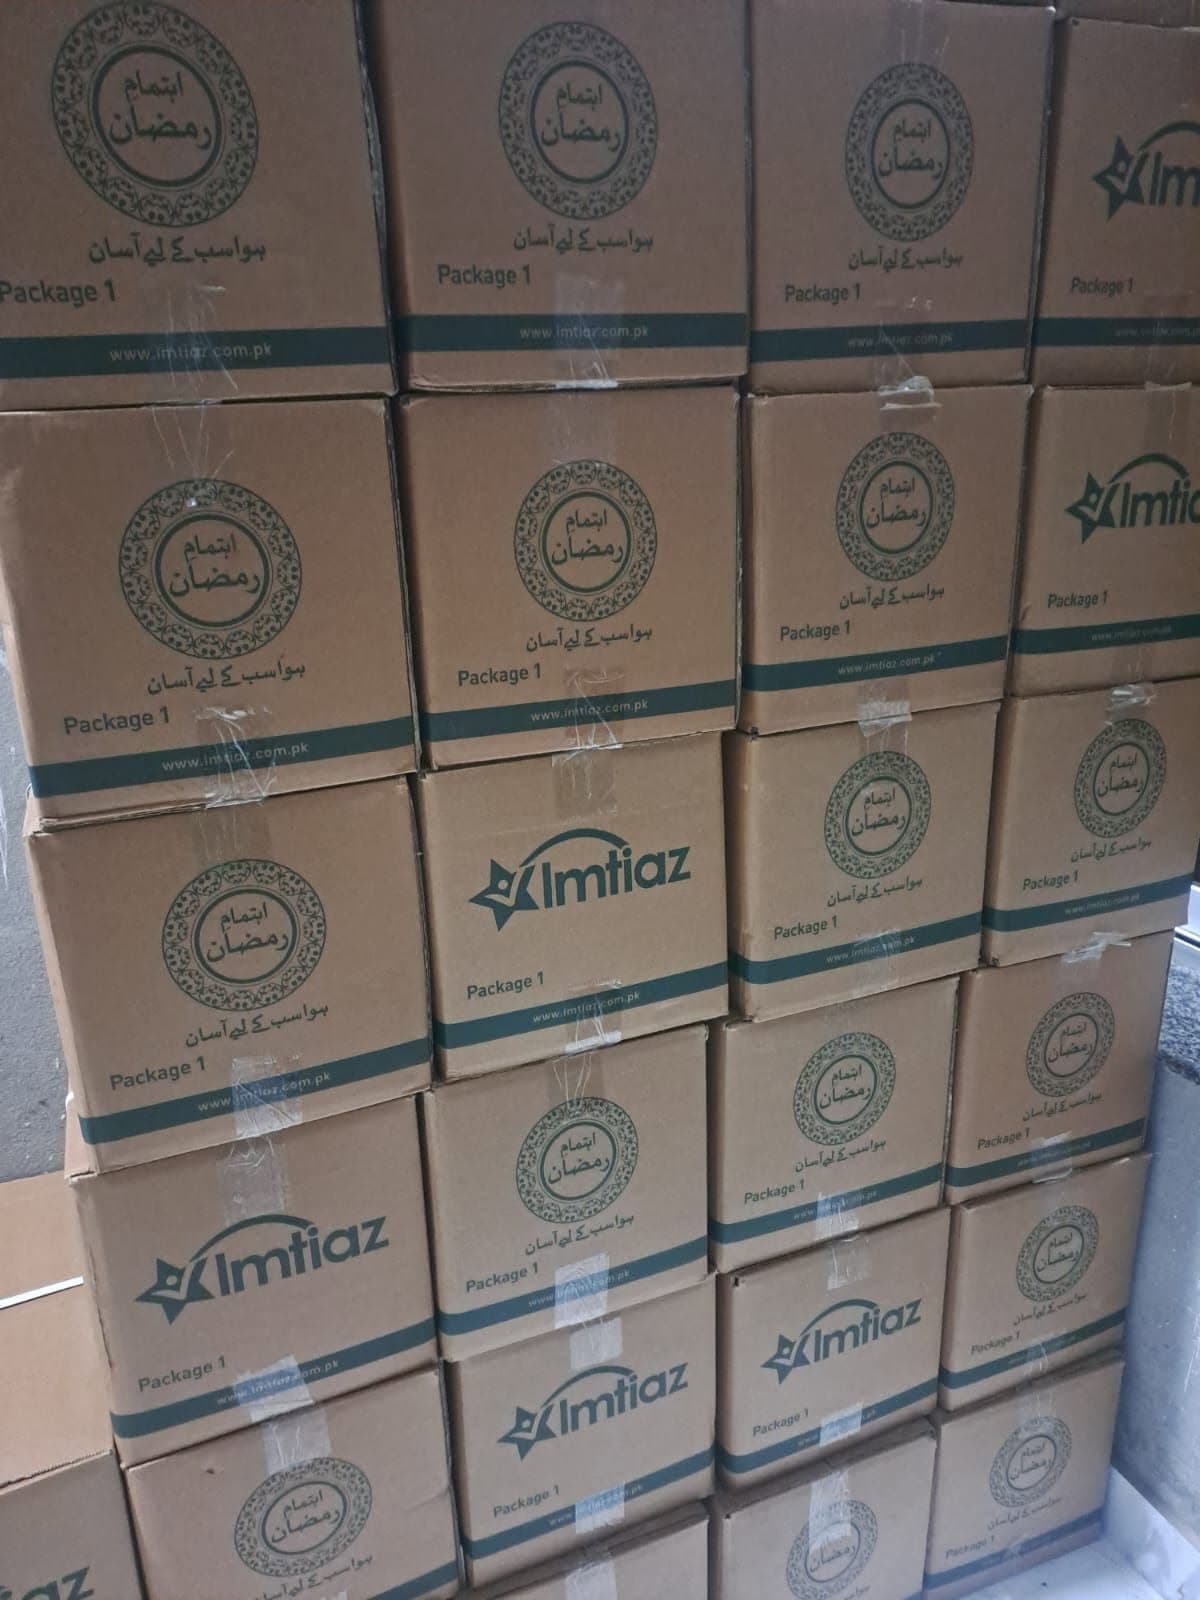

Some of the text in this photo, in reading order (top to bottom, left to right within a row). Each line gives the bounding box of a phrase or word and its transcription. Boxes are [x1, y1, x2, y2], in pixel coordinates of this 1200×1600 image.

[124, 71, 183, 103] اہتمام
[556, 81, 603, 110] اہتمام
[109, 105, 212, 150] رمضان
[541, 112, 621, 152] رمضان
[437, 264, 531, 290] Package 1
[1070, 276, 1134, 298] Package 1
[0, 278, 117, 309] Package 1
[784, 282, 861, 306] Package 1
[565, 509, 608, 534] اہتمام
[866, 502, 927, 528] رمضان
[183, 533, 237, 561] اہتمام
[551, 535, 624, 565] رمضان
[169, 561, 261, 596] رمضان
[1047, 589, 1109, 608] Package 1
[779, 619, 851, 641] Package 1
[457, 662, 541, 687] Package 1
[63, 705, 170, 736] Package 1
[542, 845, 692, 910] Imtiaz
[1022, 869, 1079, 892] Package 1
[220, 902, 268, 932] اہتمام
[774, 915, 838, 940] Package 1
[206, 931, 289, 962] رمضان
[467, 971, 544, 1000] Package 1
[533, 991, 640, 1022] www.imtiaz.com.pk
[110, 1056, 206, 1091] Package 1
[548, 1157, 610, 1184] رمضان
[744, 1178, 805, 1204] Package 1
[214, 1215, 389, 1297] Imtiaz
[465, 1261, 539, 1293] Package 1
[814, 1297, 922, 1363] Imtiaz
[138, 1354, 226, 1392] Package 1
[560, 1361, 689, 1436] Imtiaz
[752, 1408, 809, 1437] Package 1
[493, 1488, 551, 1518] Package
[553, 1484, 560, 1496] 1
[255, 1583, 288, 1600] آسا
